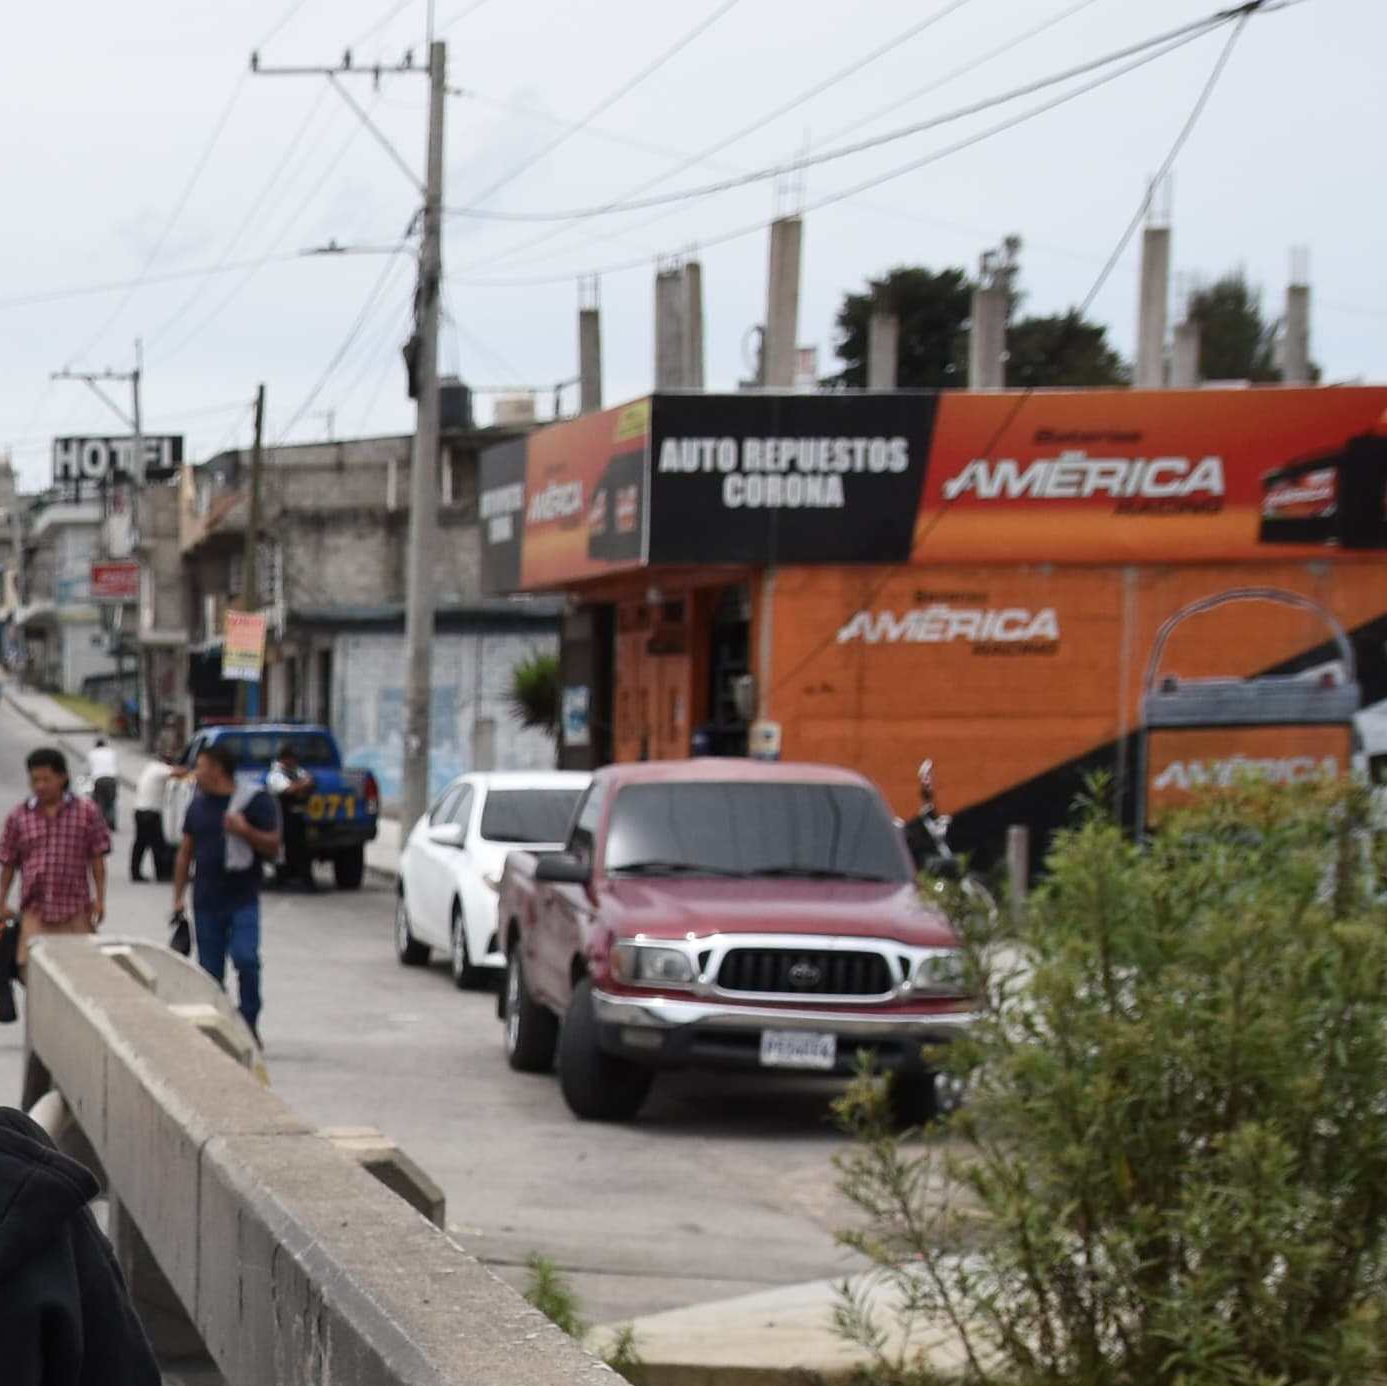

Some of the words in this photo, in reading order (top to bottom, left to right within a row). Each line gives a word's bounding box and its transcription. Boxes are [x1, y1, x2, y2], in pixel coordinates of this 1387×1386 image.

[659, 437, 738, 472] AUTO
[742, 436, 908, 472] REPUESTOS
[723, 472, 845, 508] CORONA
[942, 449, 1225, 500] AMÉRICA
[835, 603, 1060, 645] AMÉRICA
